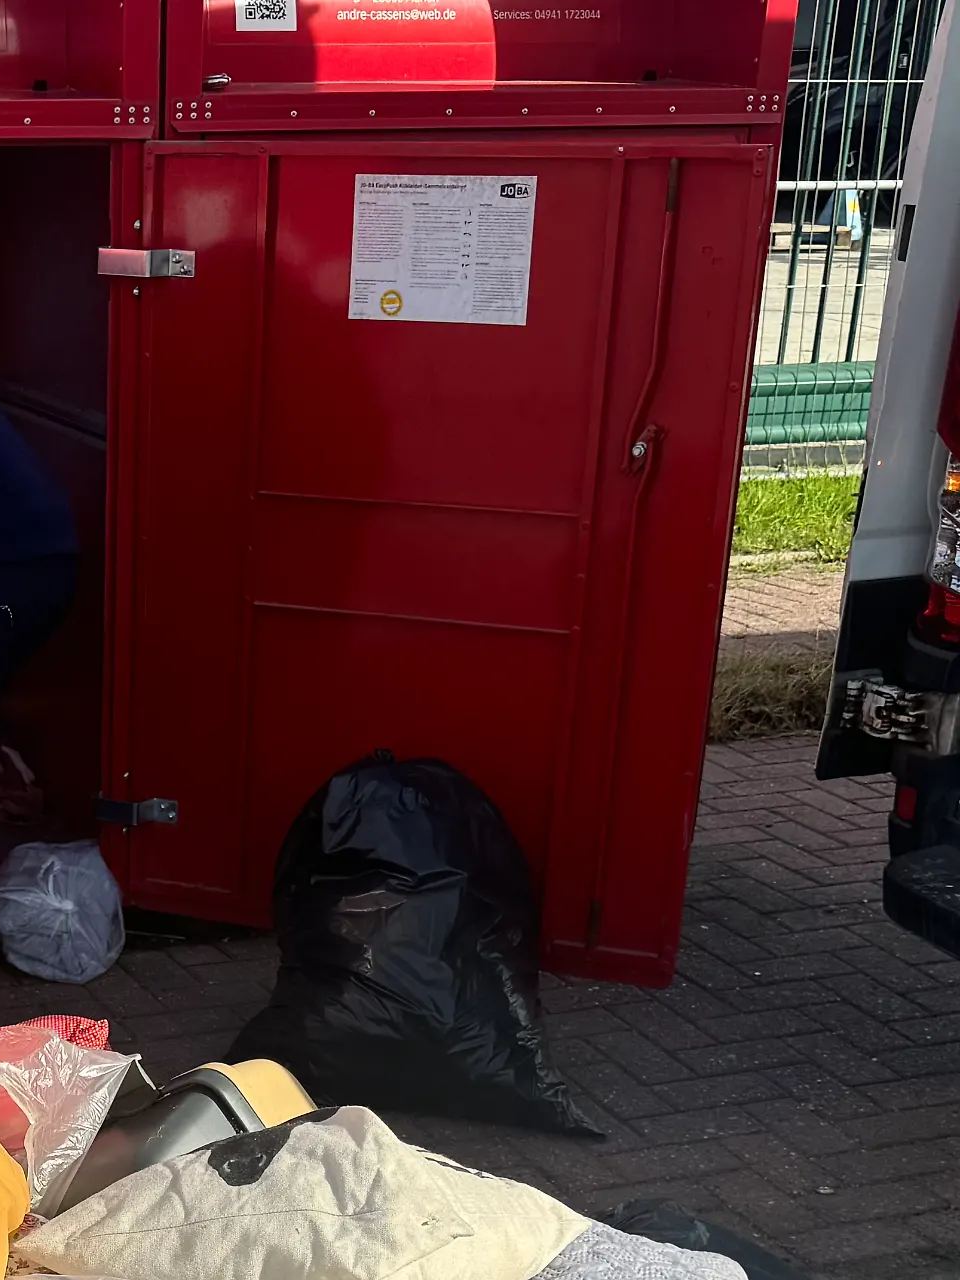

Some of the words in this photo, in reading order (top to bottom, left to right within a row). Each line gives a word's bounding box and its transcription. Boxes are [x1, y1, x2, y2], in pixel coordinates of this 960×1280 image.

[337, 9, 456, 20] andre-cassens@web.de
[493, 10, 533, 20] Services:
[535, 10, 561, 19] 04941
[564, 10, 600, 20] 1723044
